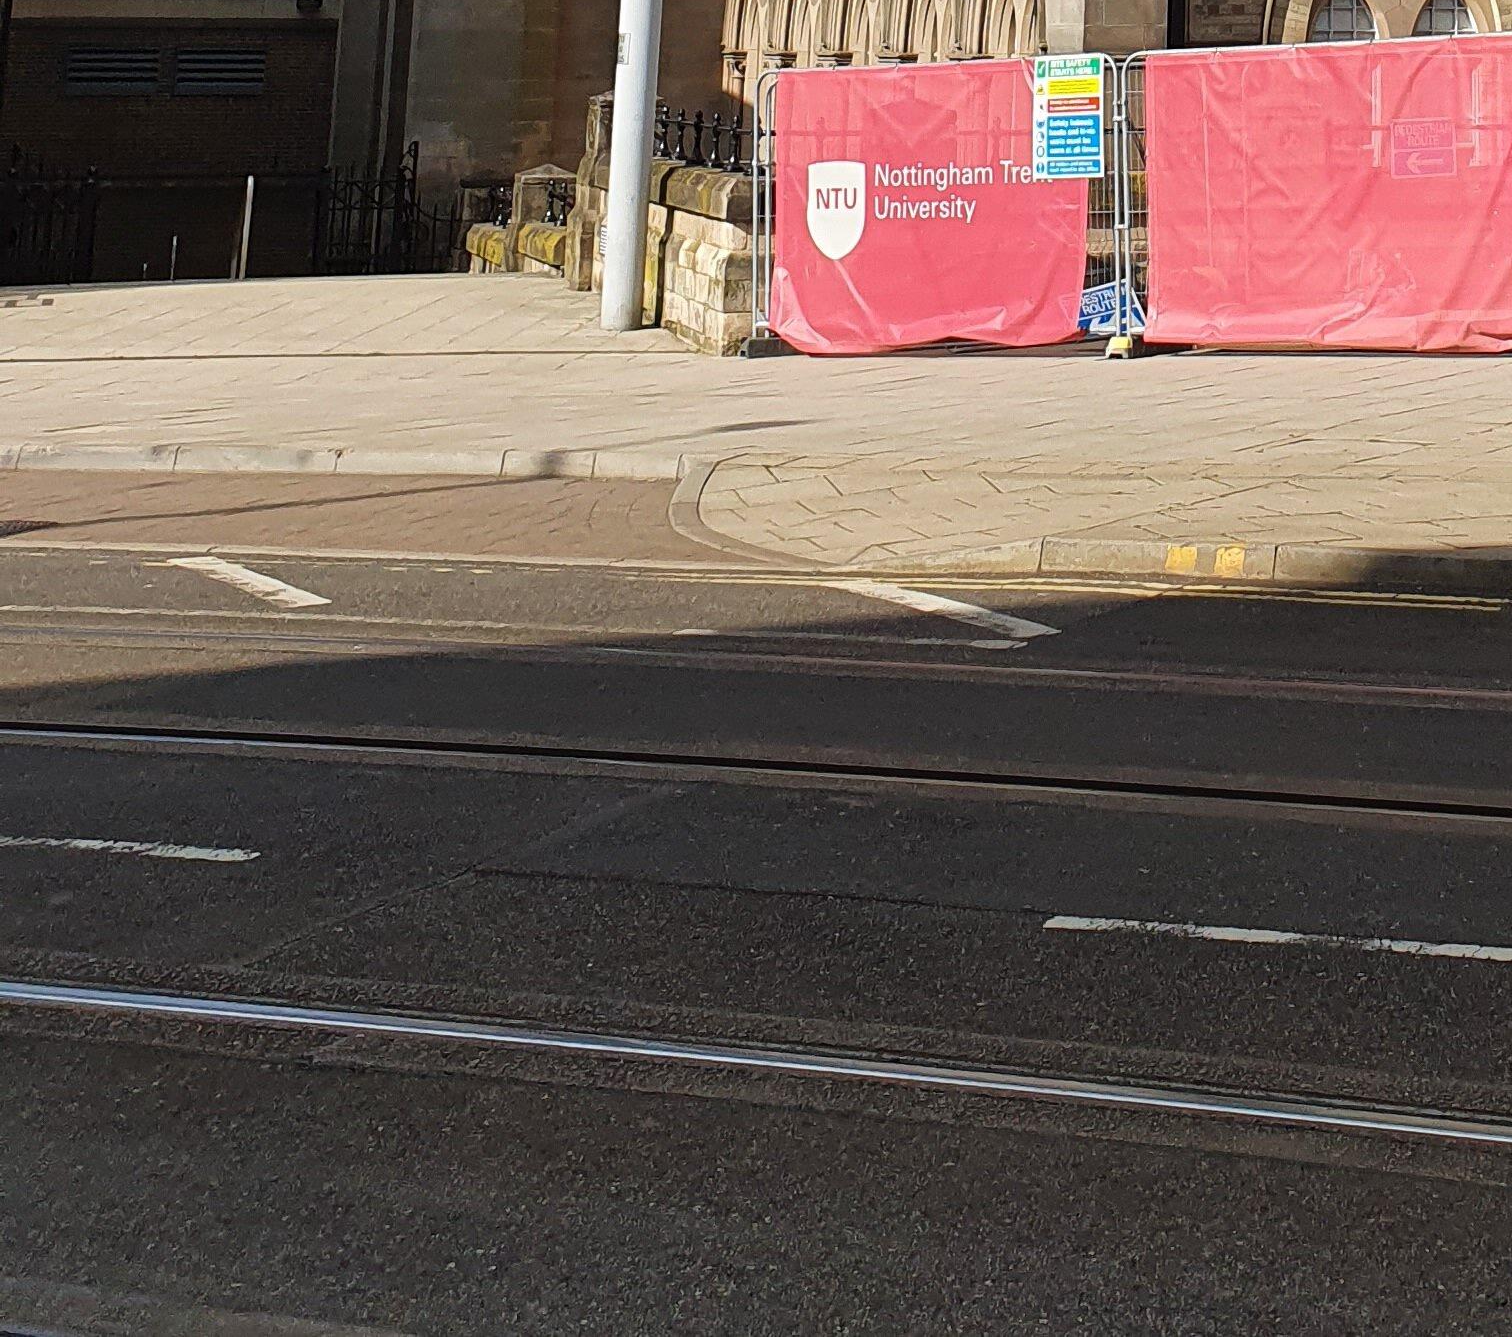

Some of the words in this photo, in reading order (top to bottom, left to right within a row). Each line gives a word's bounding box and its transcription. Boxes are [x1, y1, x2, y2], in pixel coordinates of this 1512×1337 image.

[874, 162, 993, 191] Nottingham
[1000, 159, 1053, 184] Tre
[816, 187, 857, 209] NTU
[874, 195, 976, 223] University
